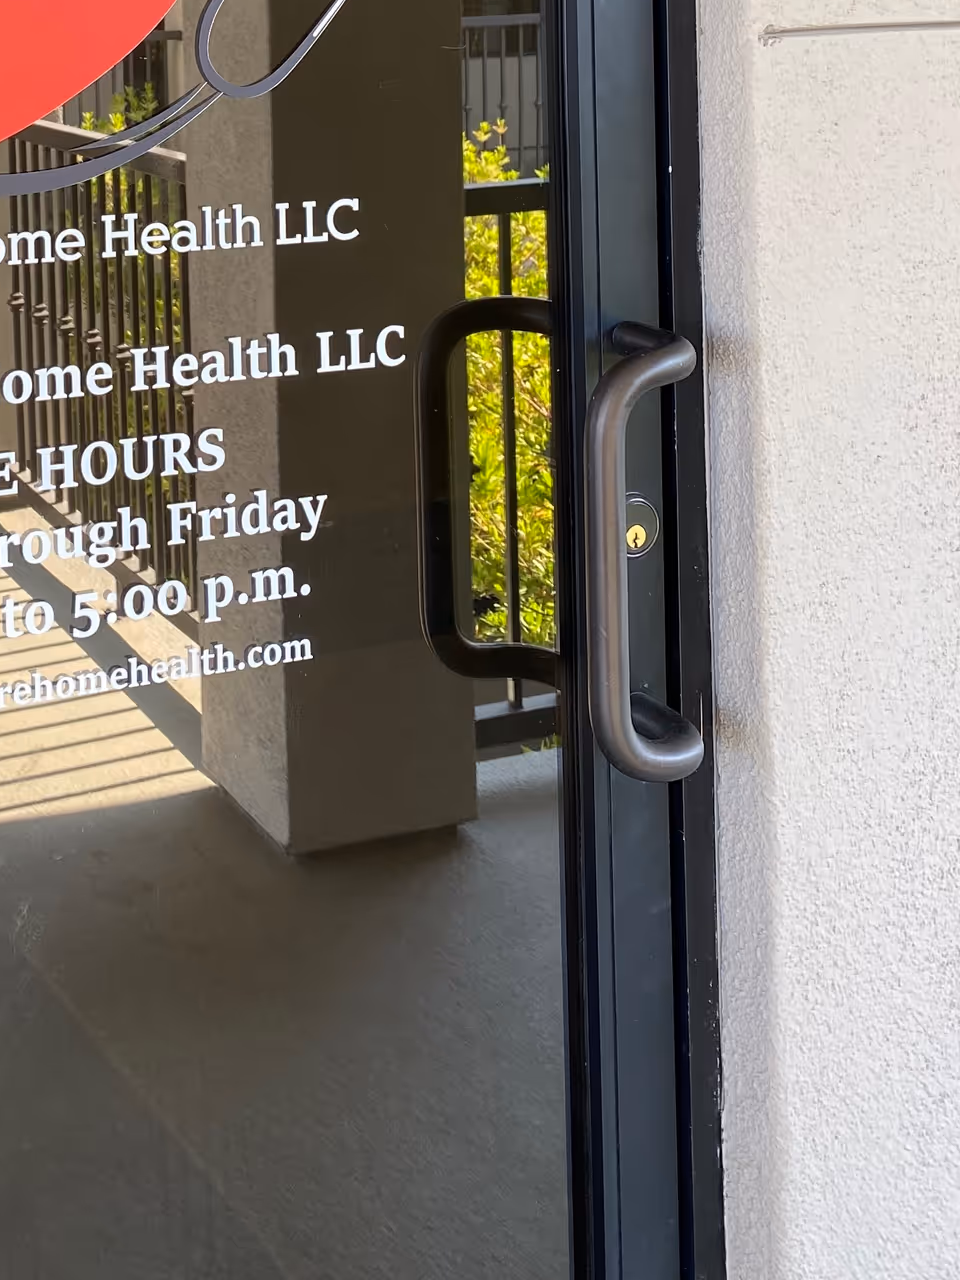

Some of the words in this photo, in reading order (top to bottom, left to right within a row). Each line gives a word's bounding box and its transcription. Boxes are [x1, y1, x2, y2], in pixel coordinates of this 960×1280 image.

[101, 203, 264, 260] Health
[275, 197, 361, 246] LLC
[129, 332, 300, 392] Health
[315, 324, 407, 374] LLC
[37, 428, 227, 493] HOURS
[167, 489, 328, 546] Friday
[2, 596, 55, 639] to
[71, 577, 188, 639] 5:00
[203, 564, 312, 624] p.m.
